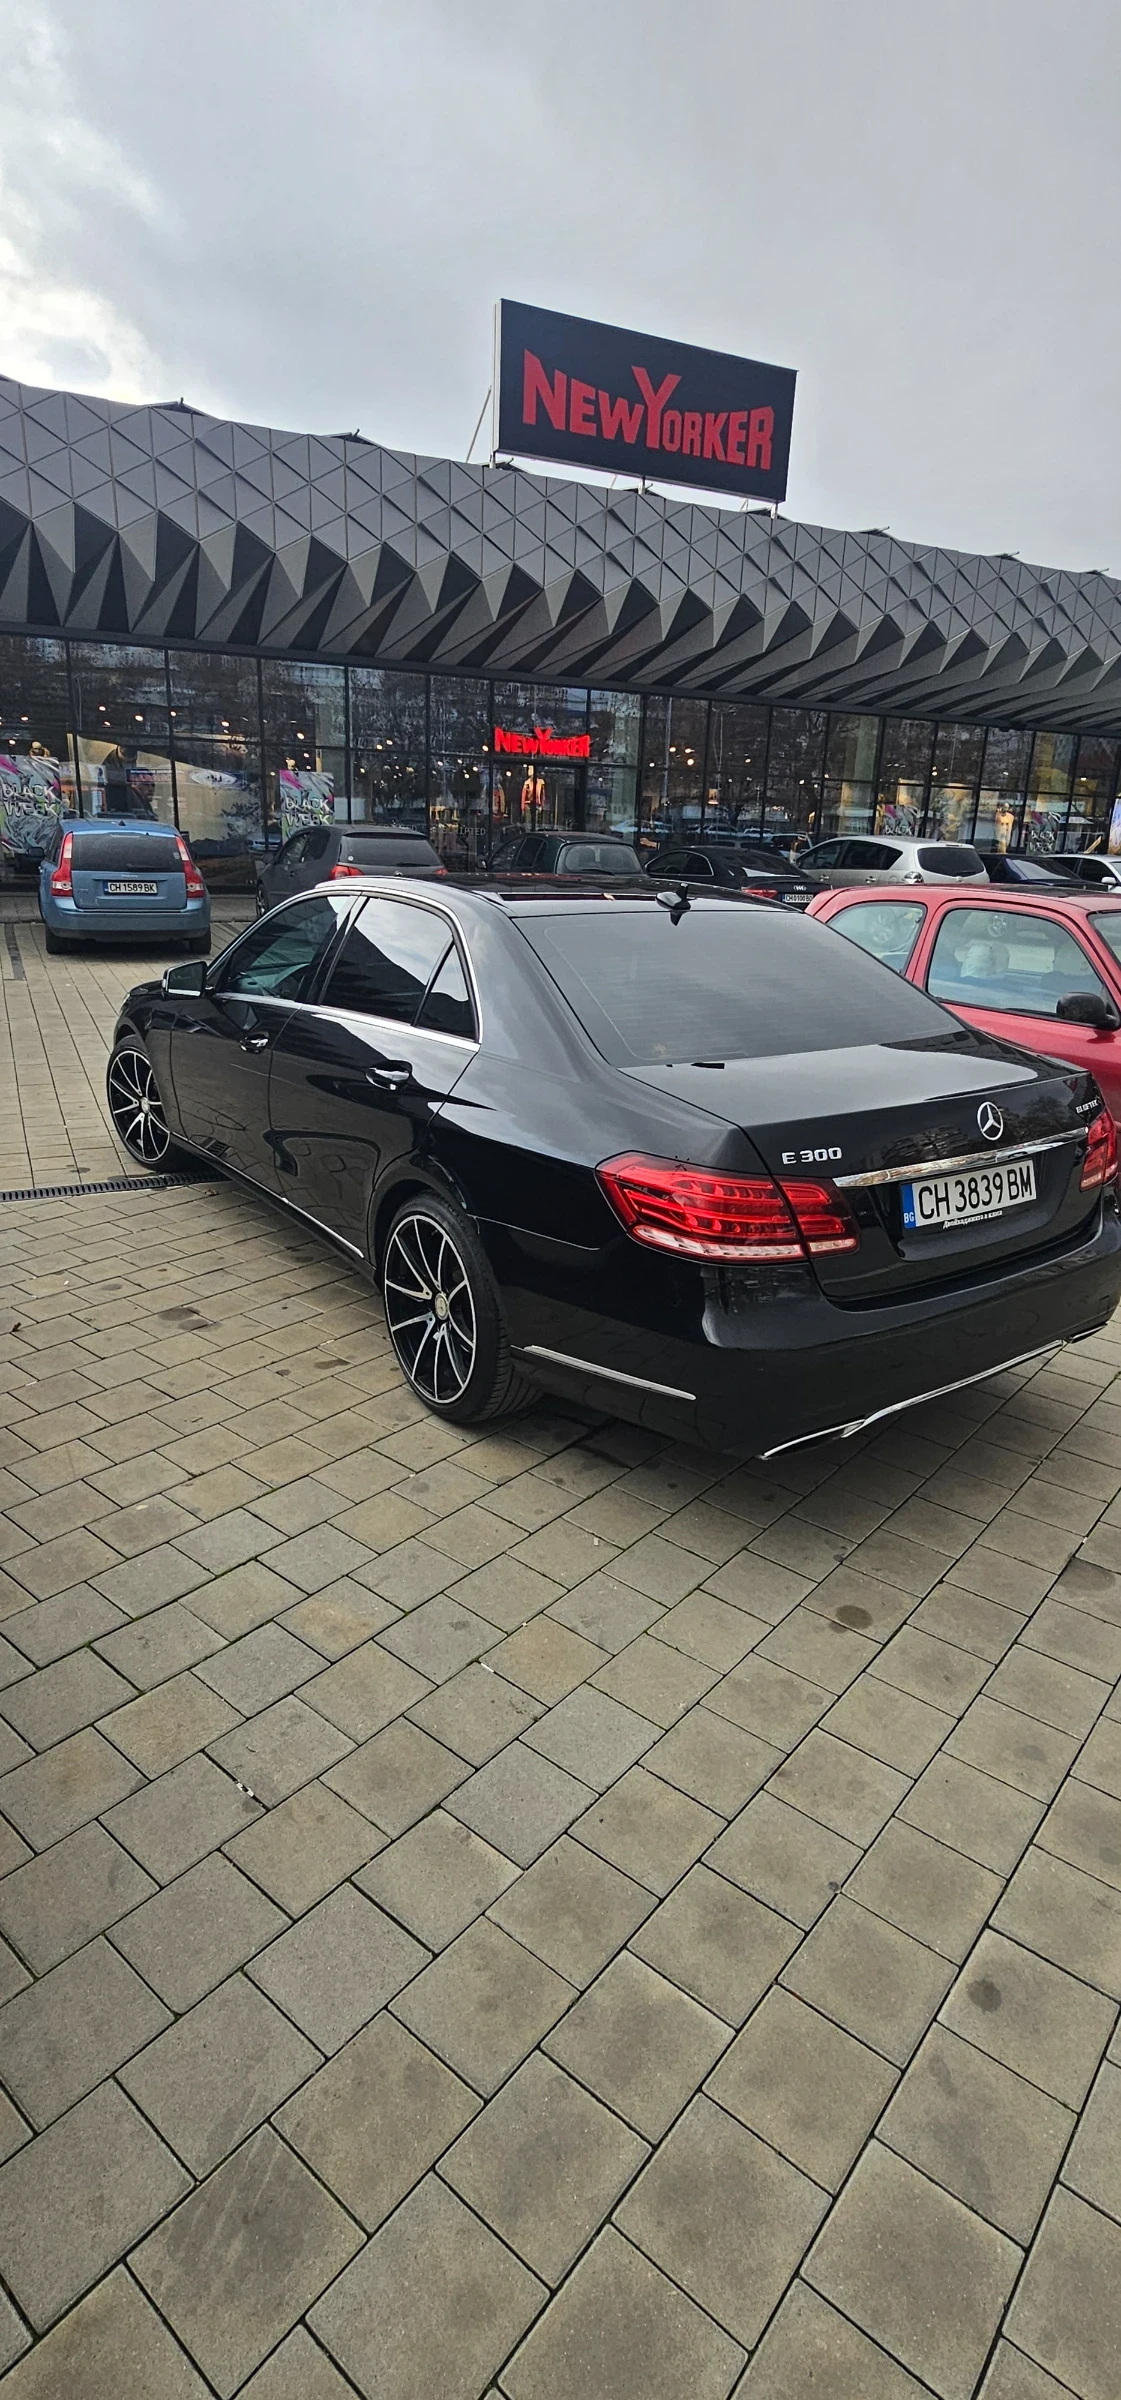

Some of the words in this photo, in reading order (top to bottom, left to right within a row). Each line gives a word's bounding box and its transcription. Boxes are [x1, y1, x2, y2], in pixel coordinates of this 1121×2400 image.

[3, 783, 60, 801] BLACK
[3, 801, 60, 818] WEEK
[285, 796, 333, 812] BLACK
[286, 813, 330, 827] WEEK
[109, 883, 121, 892] CH
[123, 883, 143, 892] 1589
[144, 883, 155, 892] BK
[781, 1151, 797, 1165] E
[799, 1147, 842, 1162] 300
[918, 1182, 951, 1220] CH
[954, 1172, 1003, 1212] 3839
[1006, 1165, 1033, 1201] BM
[903, 1212, 914, 1224] BG
